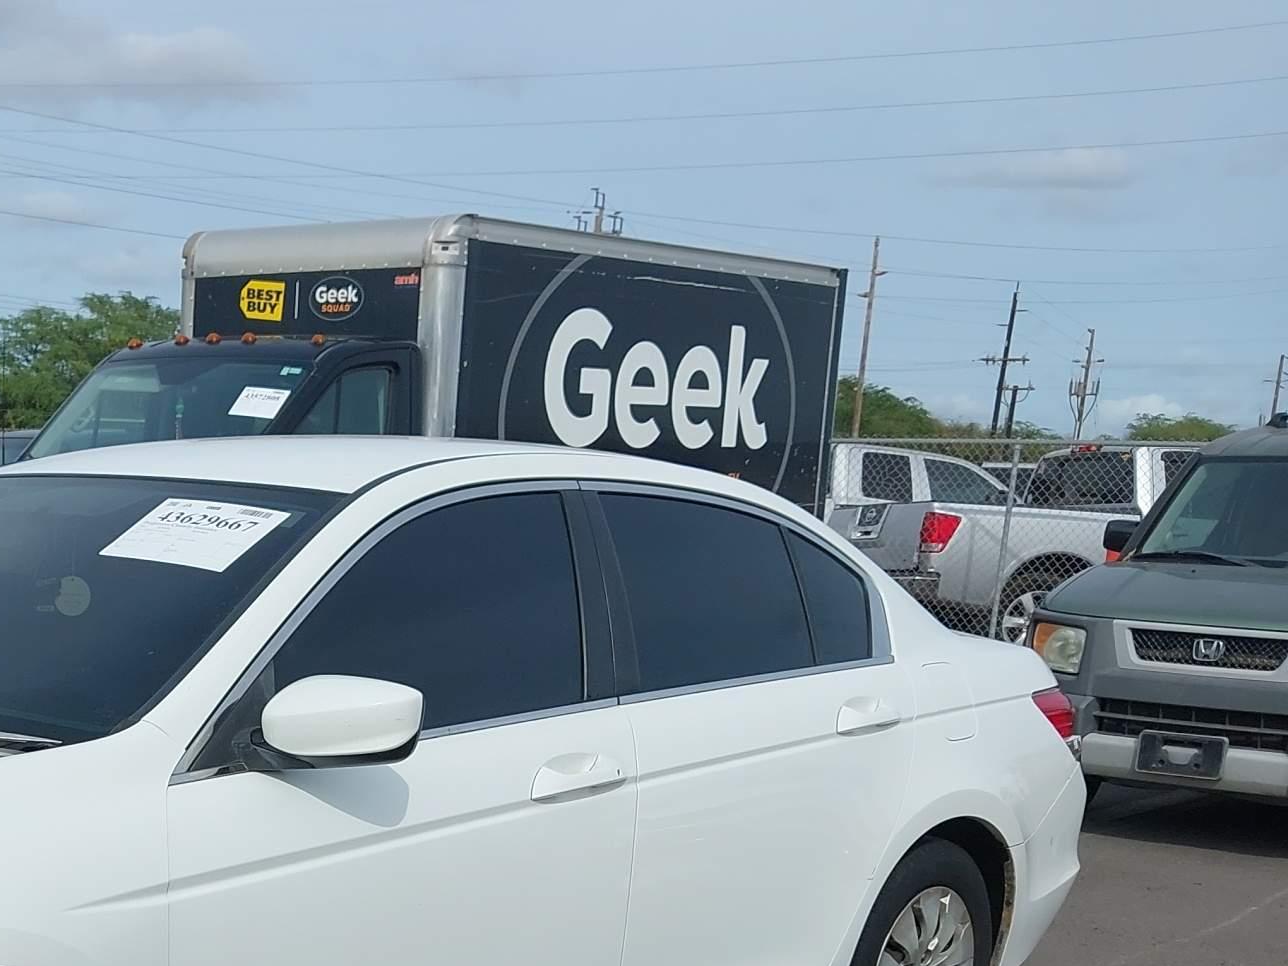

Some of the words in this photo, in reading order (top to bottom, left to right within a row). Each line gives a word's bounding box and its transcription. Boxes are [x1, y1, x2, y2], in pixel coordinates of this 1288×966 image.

[246, 288, 283, 301] BEST
[315, 284, 359, 304] Geek
[247, 301, 280, 314] BUY
[321, 304, 351, 313] SQUAD
[544, 307, 770, 450] Geek
[157, 511, 260, 532] 43629667
